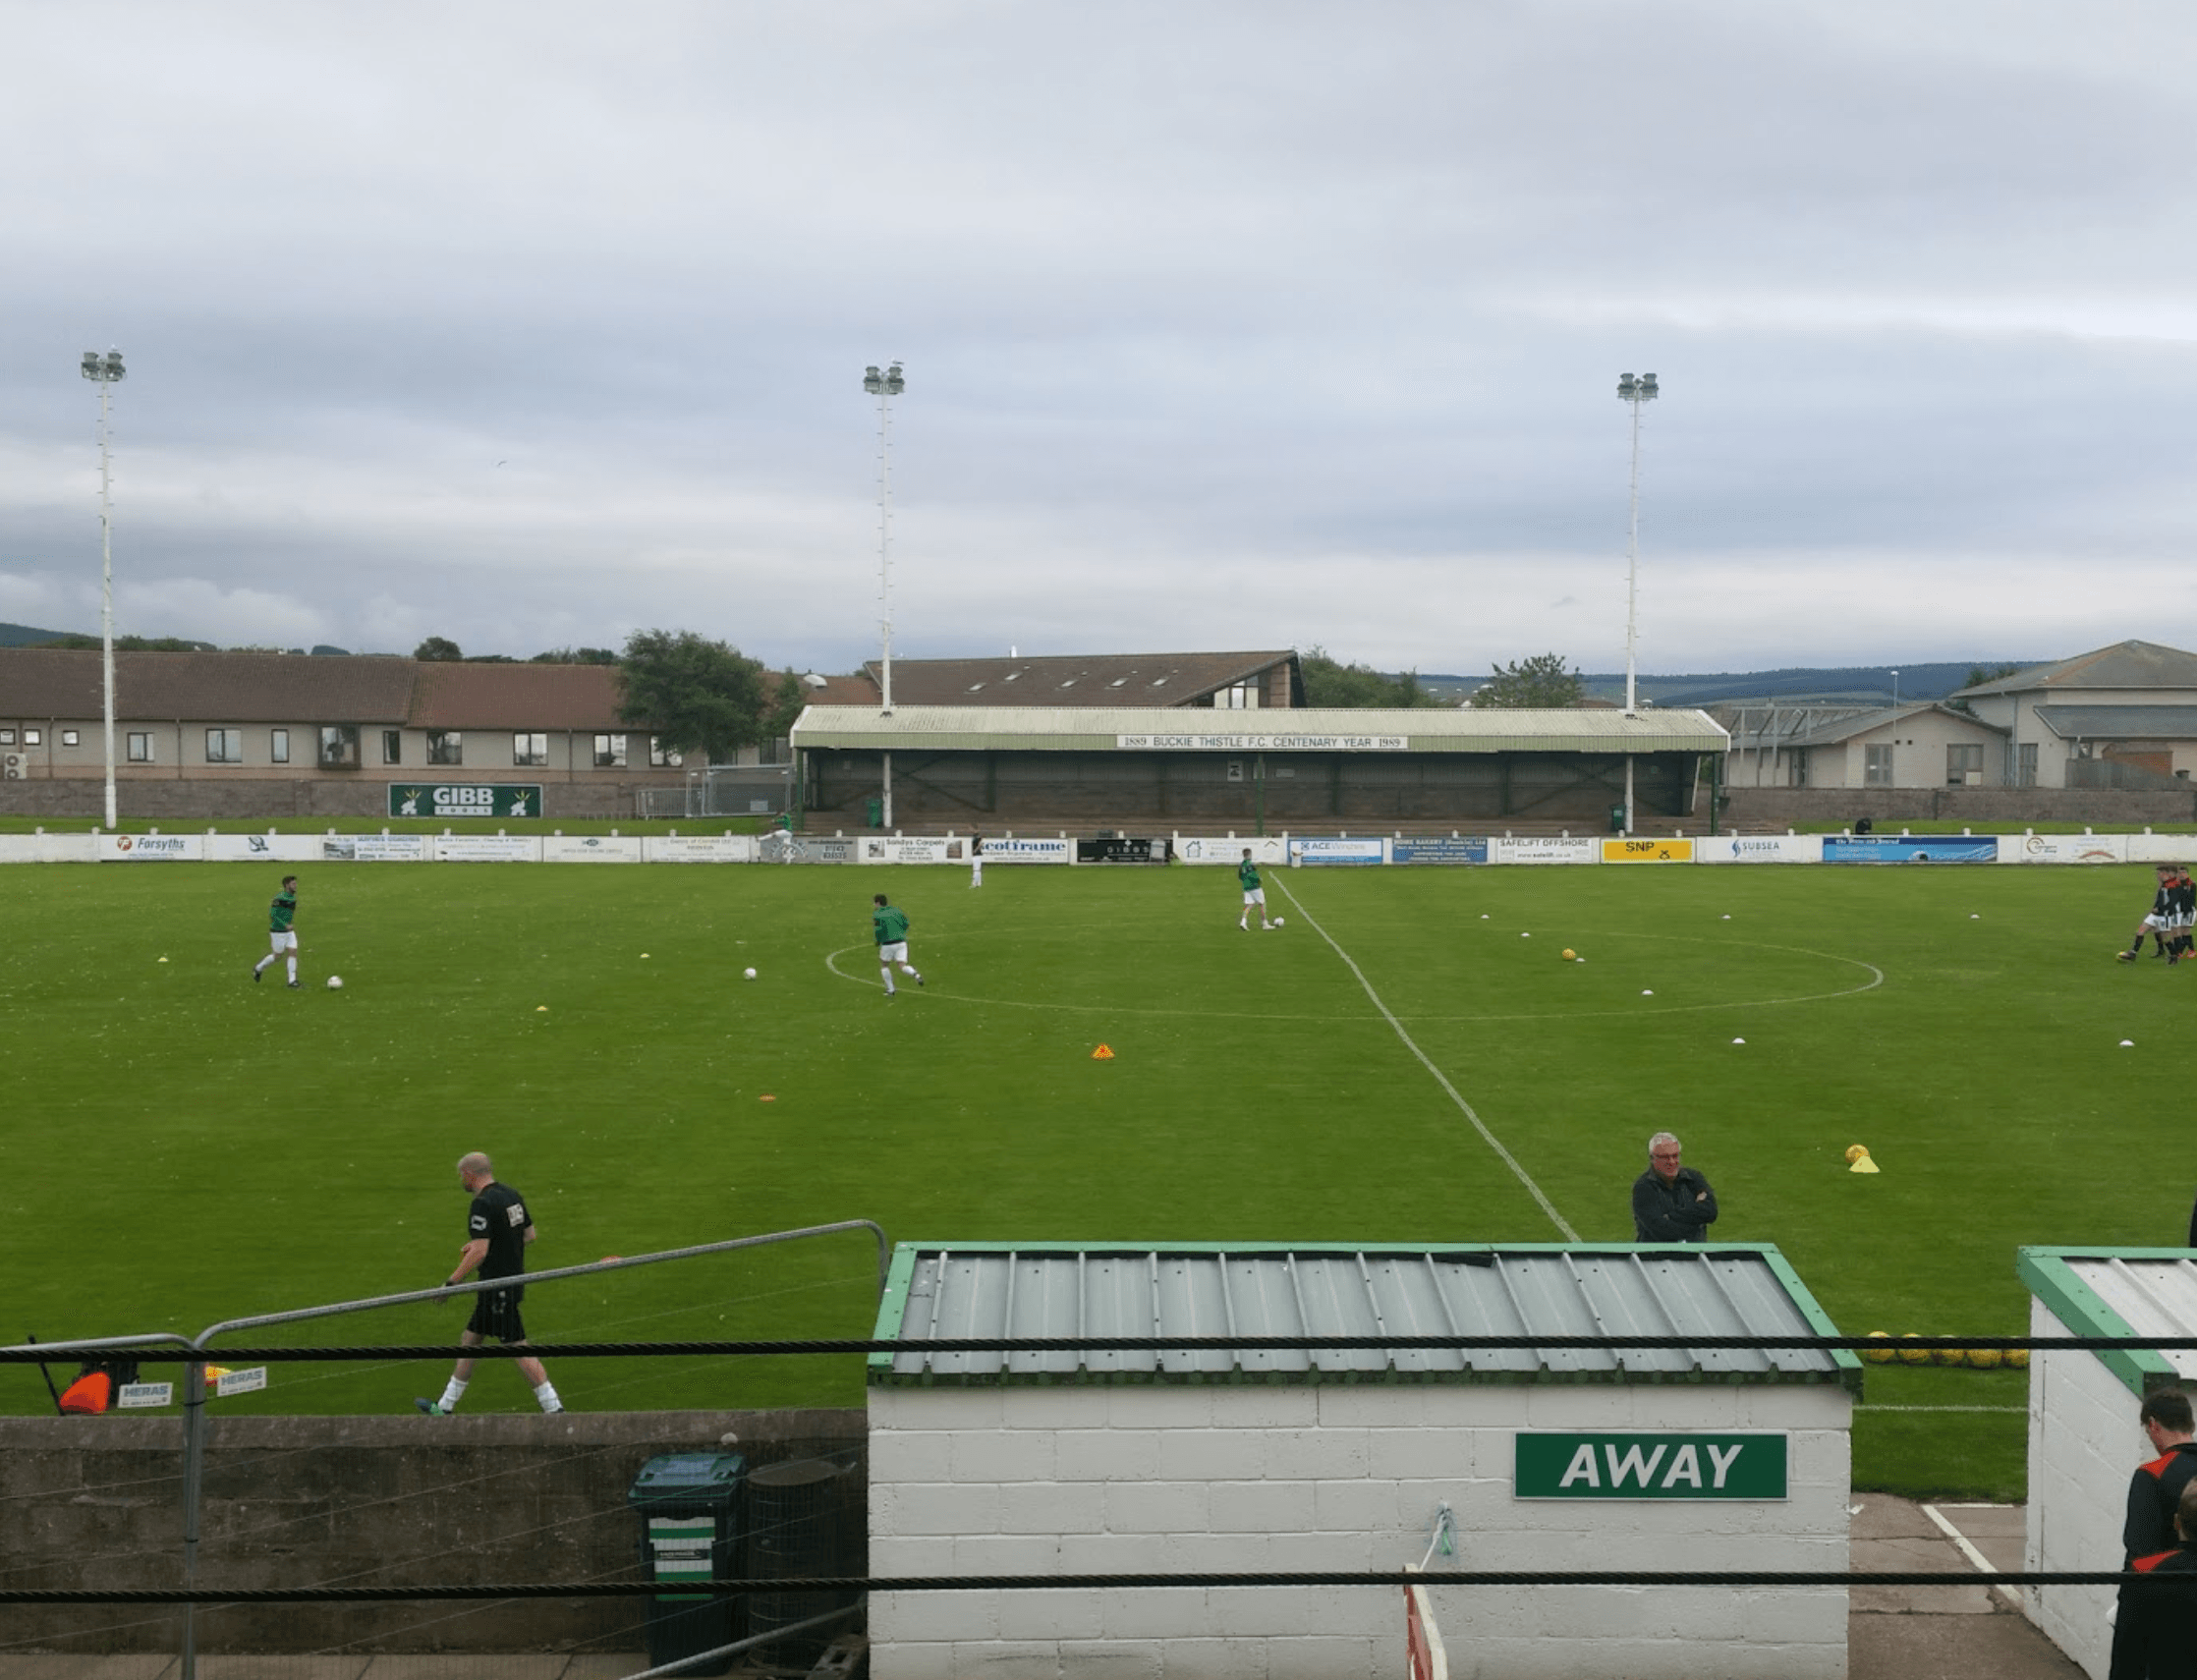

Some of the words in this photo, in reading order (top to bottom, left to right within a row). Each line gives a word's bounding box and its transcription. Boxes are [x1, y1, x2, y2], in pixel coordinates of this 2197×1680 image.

[1124, 736, 1147, 747] 1889
[1153, 736, 1193, 747] BUCKIE
[1199, 736, 1243, 748] THISTLE
[1248, 736, 1268, 748] F.C.
[1272, 737, 1337, 748] CENTENARY
[1343, 737, 1372, 748] YEAR
[1379, 737, 1401, 748] 1989
[432, 787, 494, 806] GIBB
[138, 837, 186, 852] Forsyths
[1625, 841, 1655, 853] SNP
[1742, 842, 1779, 851] SUBSEA
[219, 1370, 263, 1386] HERAS
[123, 1384, 169, 1397] HERAS
[1558, 1443, 1744, 1489] AWAY
